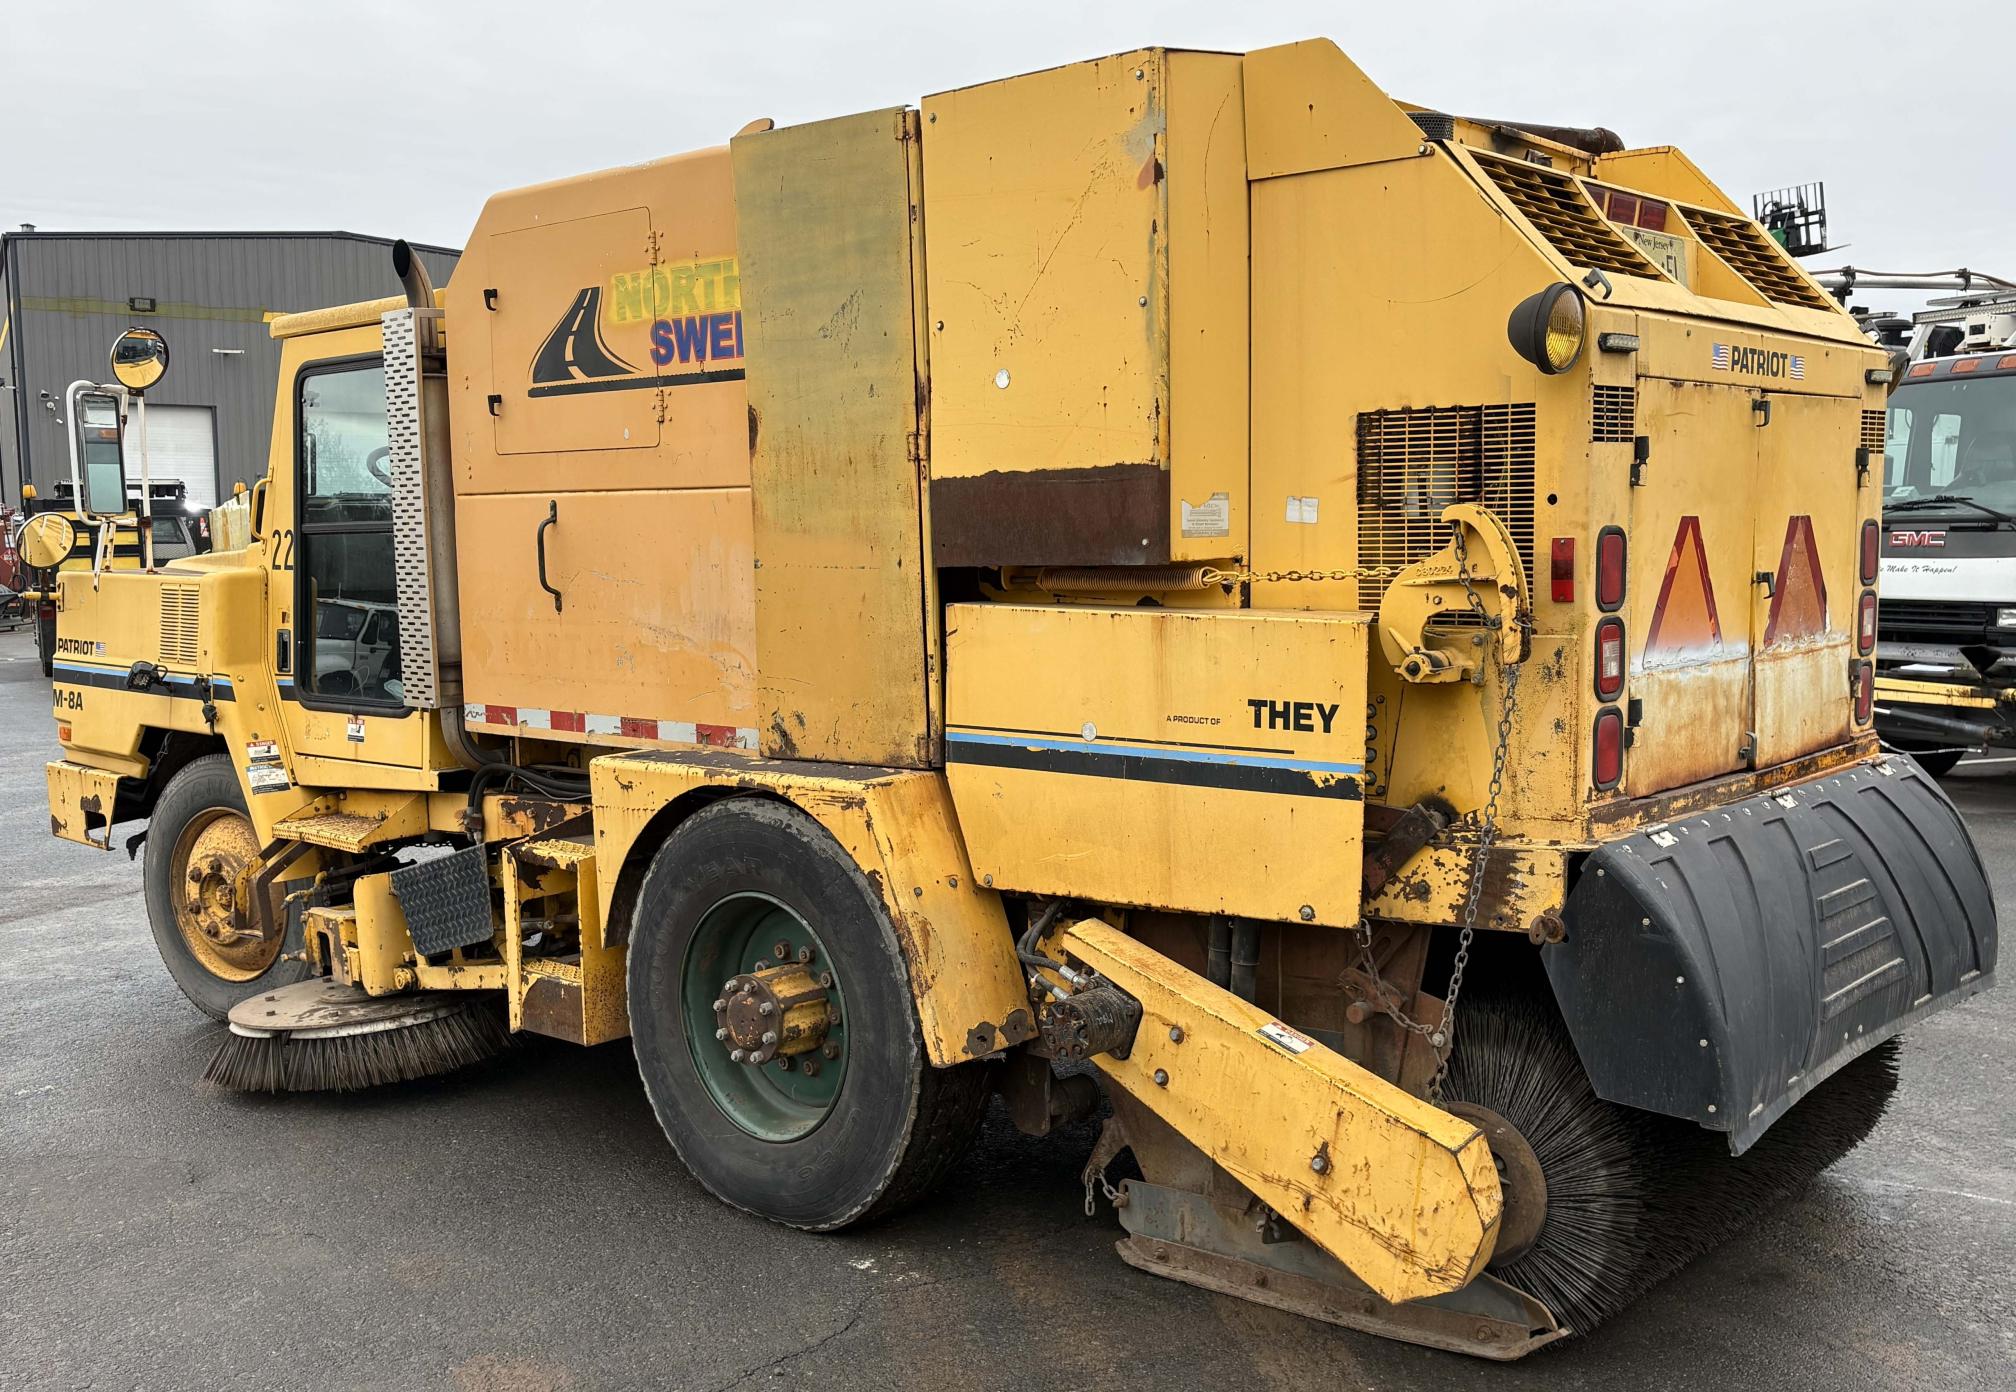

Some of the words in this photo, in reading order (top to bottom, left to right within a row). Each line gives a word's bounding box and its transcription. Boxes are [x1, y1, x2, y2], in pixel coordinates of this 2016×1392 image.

[1638, 233, 1652, 247] New
[1652, 237, 1669, 252] Jersey
[1731, 345, 1788, 378] PATRIOT
[1888, 531, 1946, 547] GMC
[272, 529, 294, 570] 22
[1887, 565, 1909, 573] Make
[1922, 565, 1958, 574] Happen!
[57, 638, 95, 656] PATRIOT
[53, 688, 83, 711] M-8A
[1173, 715, 1209, 724] PRODUCT
[1210, 717, 1221, 725] OF
[1247, 698, 1340, 734] THEY
